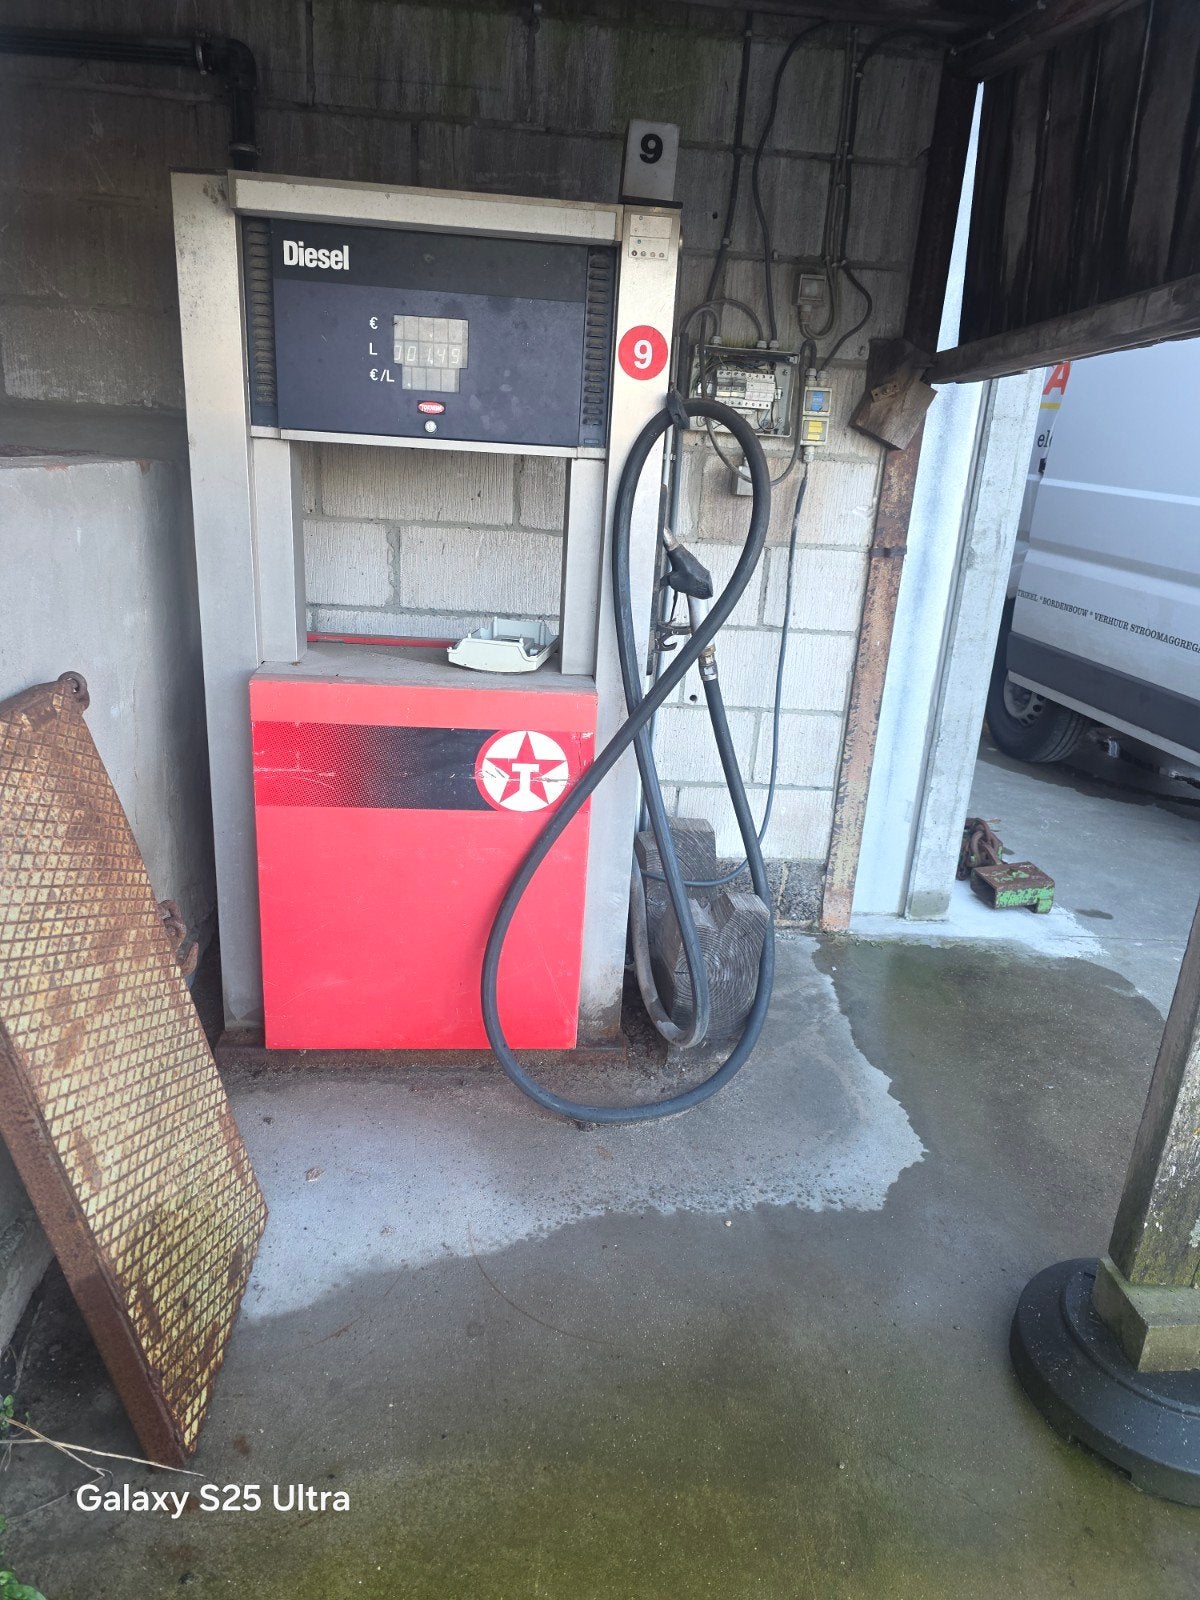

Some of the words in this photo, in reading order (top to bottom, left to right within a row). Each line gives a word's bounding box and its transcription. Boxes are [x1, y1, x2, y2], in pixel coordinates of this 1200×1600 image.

[640, 133, 663, 164] 9
[283, 240, 349, 270] Diesel
[369, 316, 378, 330] €
[369, 342, 378, 355] L
[633, 339, 653, 370] 9
[369, 368, 395, 382] €/L
[1042, 360, 1071, 396] A
[1037, 430, 1053, 447] el
[1094, 612, 1129, 630] VERHUUR
